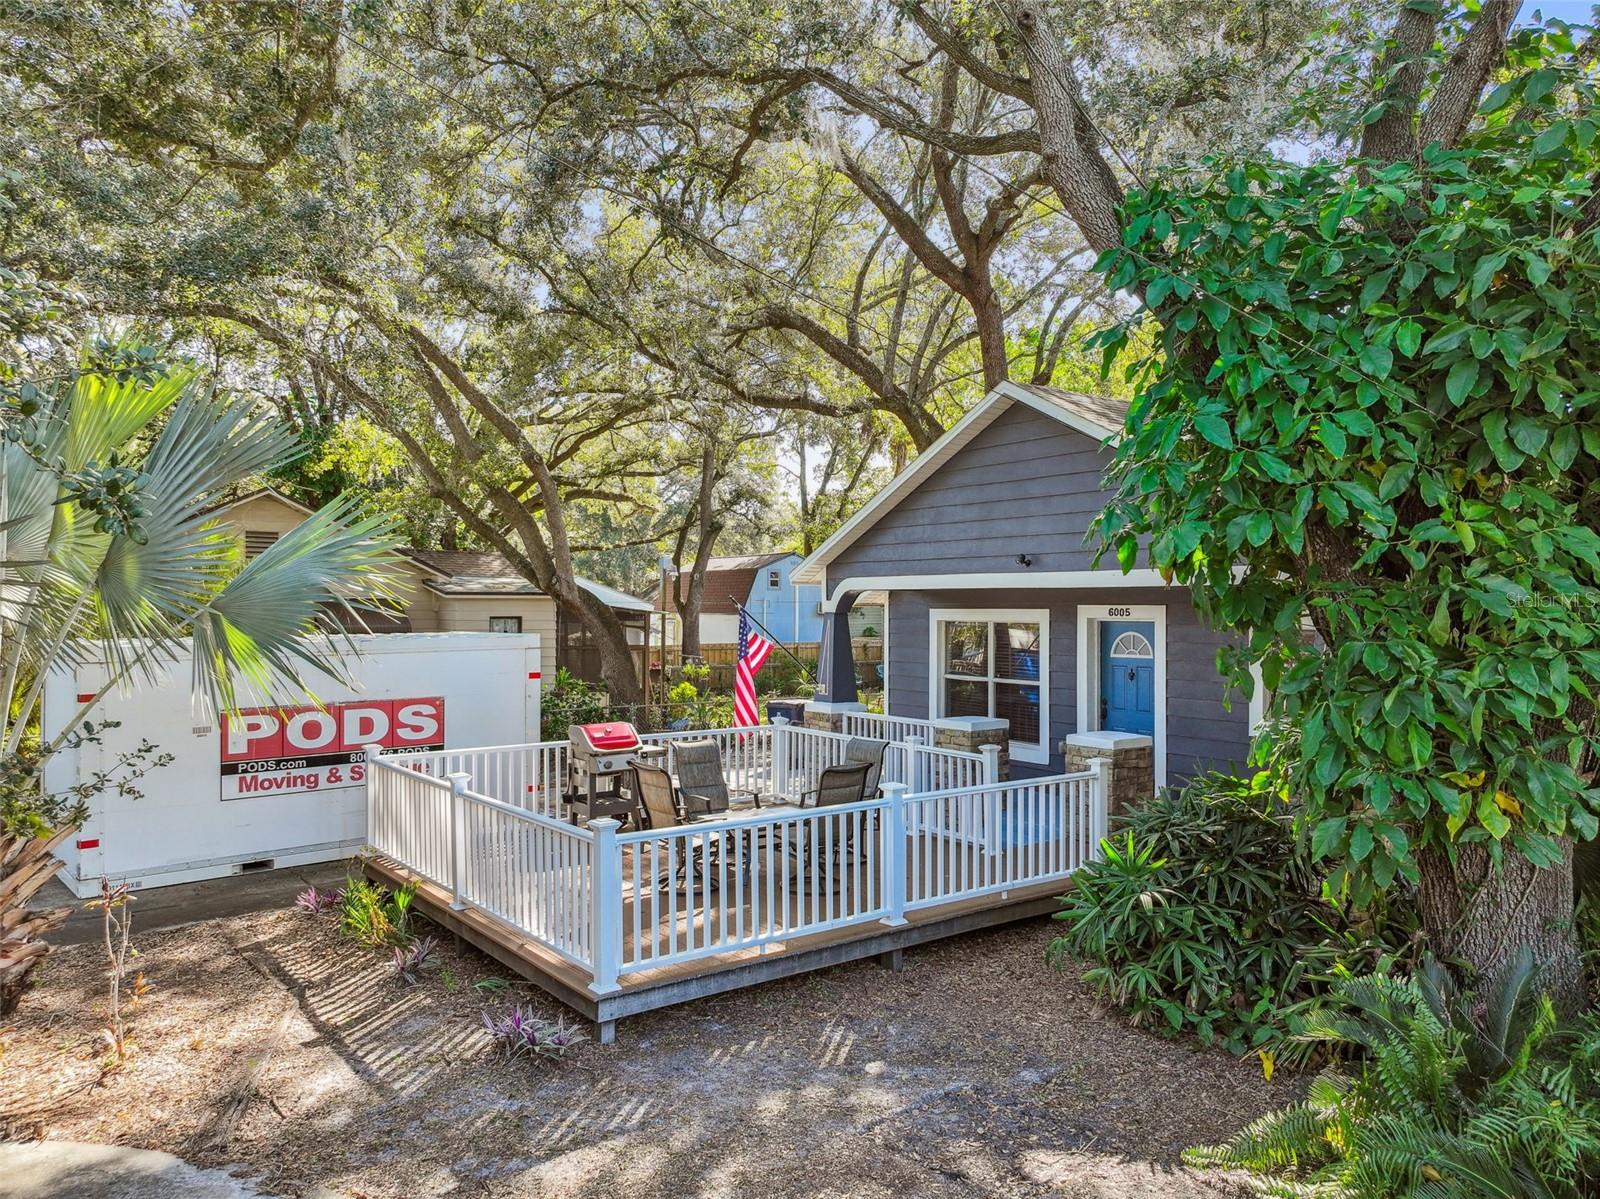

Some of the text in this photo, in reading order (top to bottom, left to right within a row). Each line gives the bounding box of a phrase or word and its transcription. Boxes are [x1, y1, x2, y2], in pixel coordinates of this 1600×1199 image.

[1108, 607, 1131, 617] 6005
[228, 704, 439, 755] PODS
[238, 760, 307, 774] PODS.com
[238, 771, 320, 793] Moving
[326, 767, 344, 784] &
